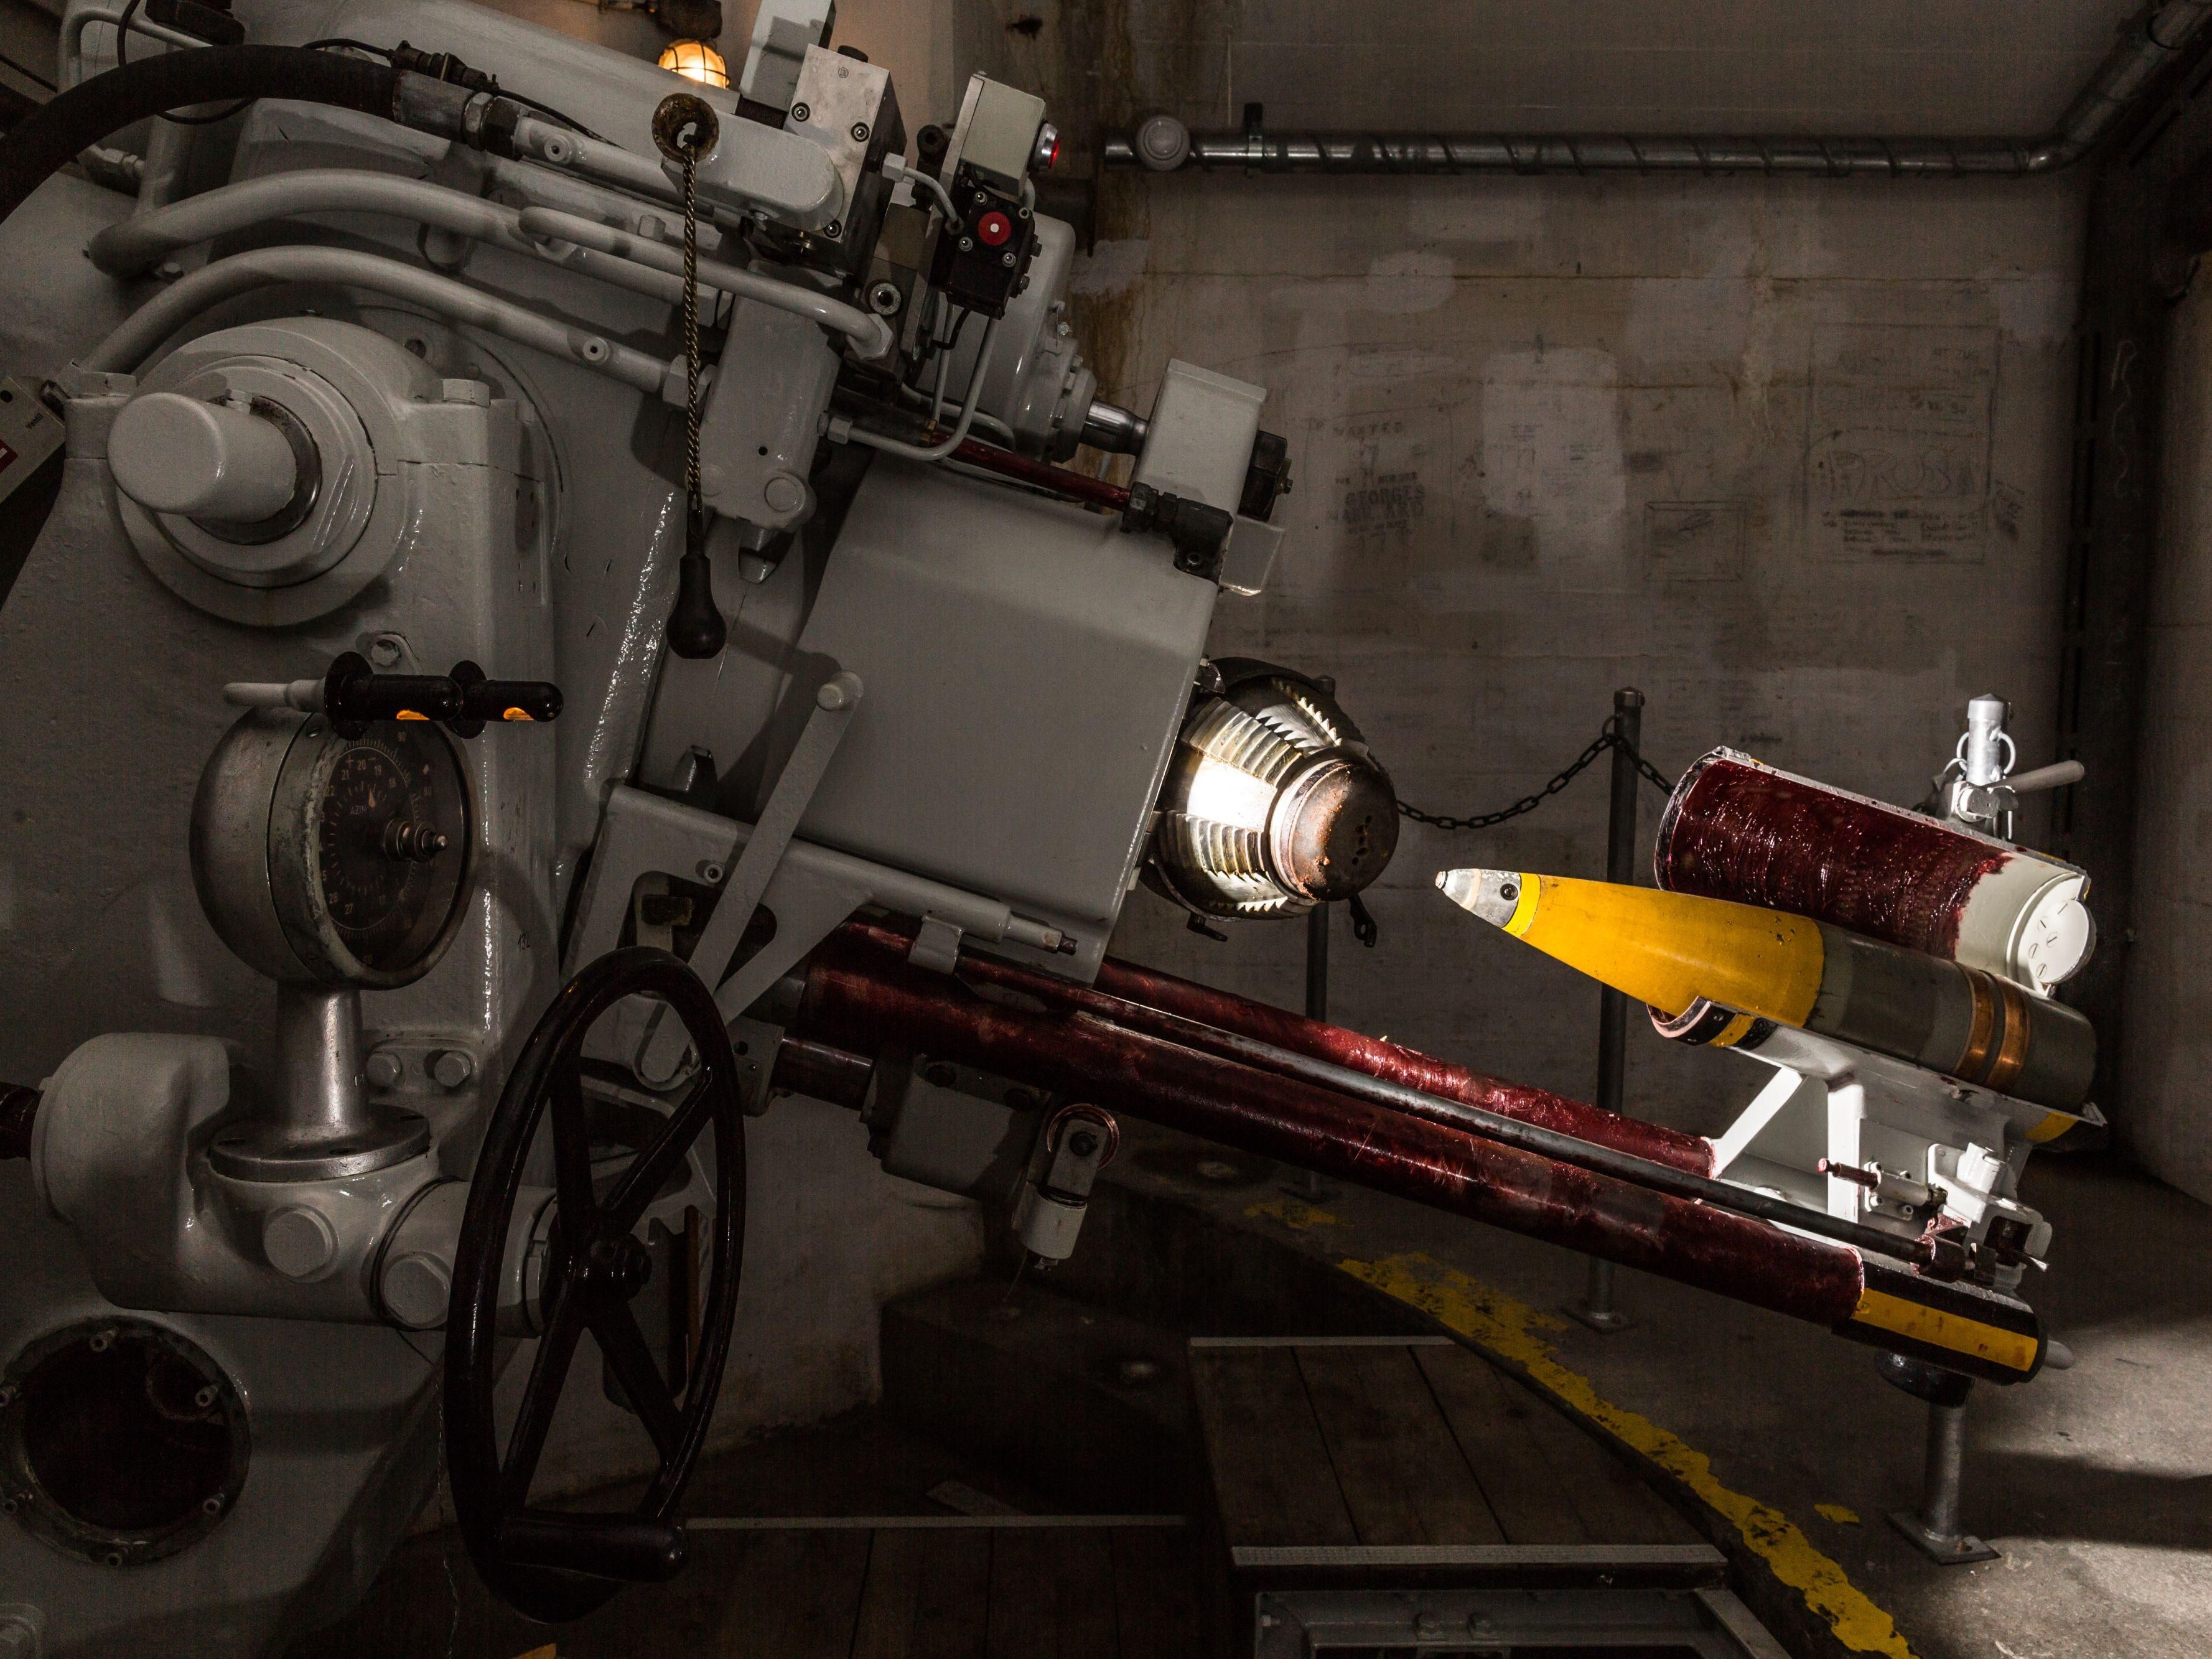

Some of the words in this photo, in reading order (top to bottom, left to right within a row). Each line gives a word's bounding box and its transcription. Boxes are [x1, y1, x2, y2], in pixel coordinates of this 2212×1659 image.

[25, 413, 43, 428] Ventil
[357, 759, 367, 771] 20
[374, 765, 382, 776] 19
[341, 769, 350, 781] 21
[345, 903, 353, 915] 27
